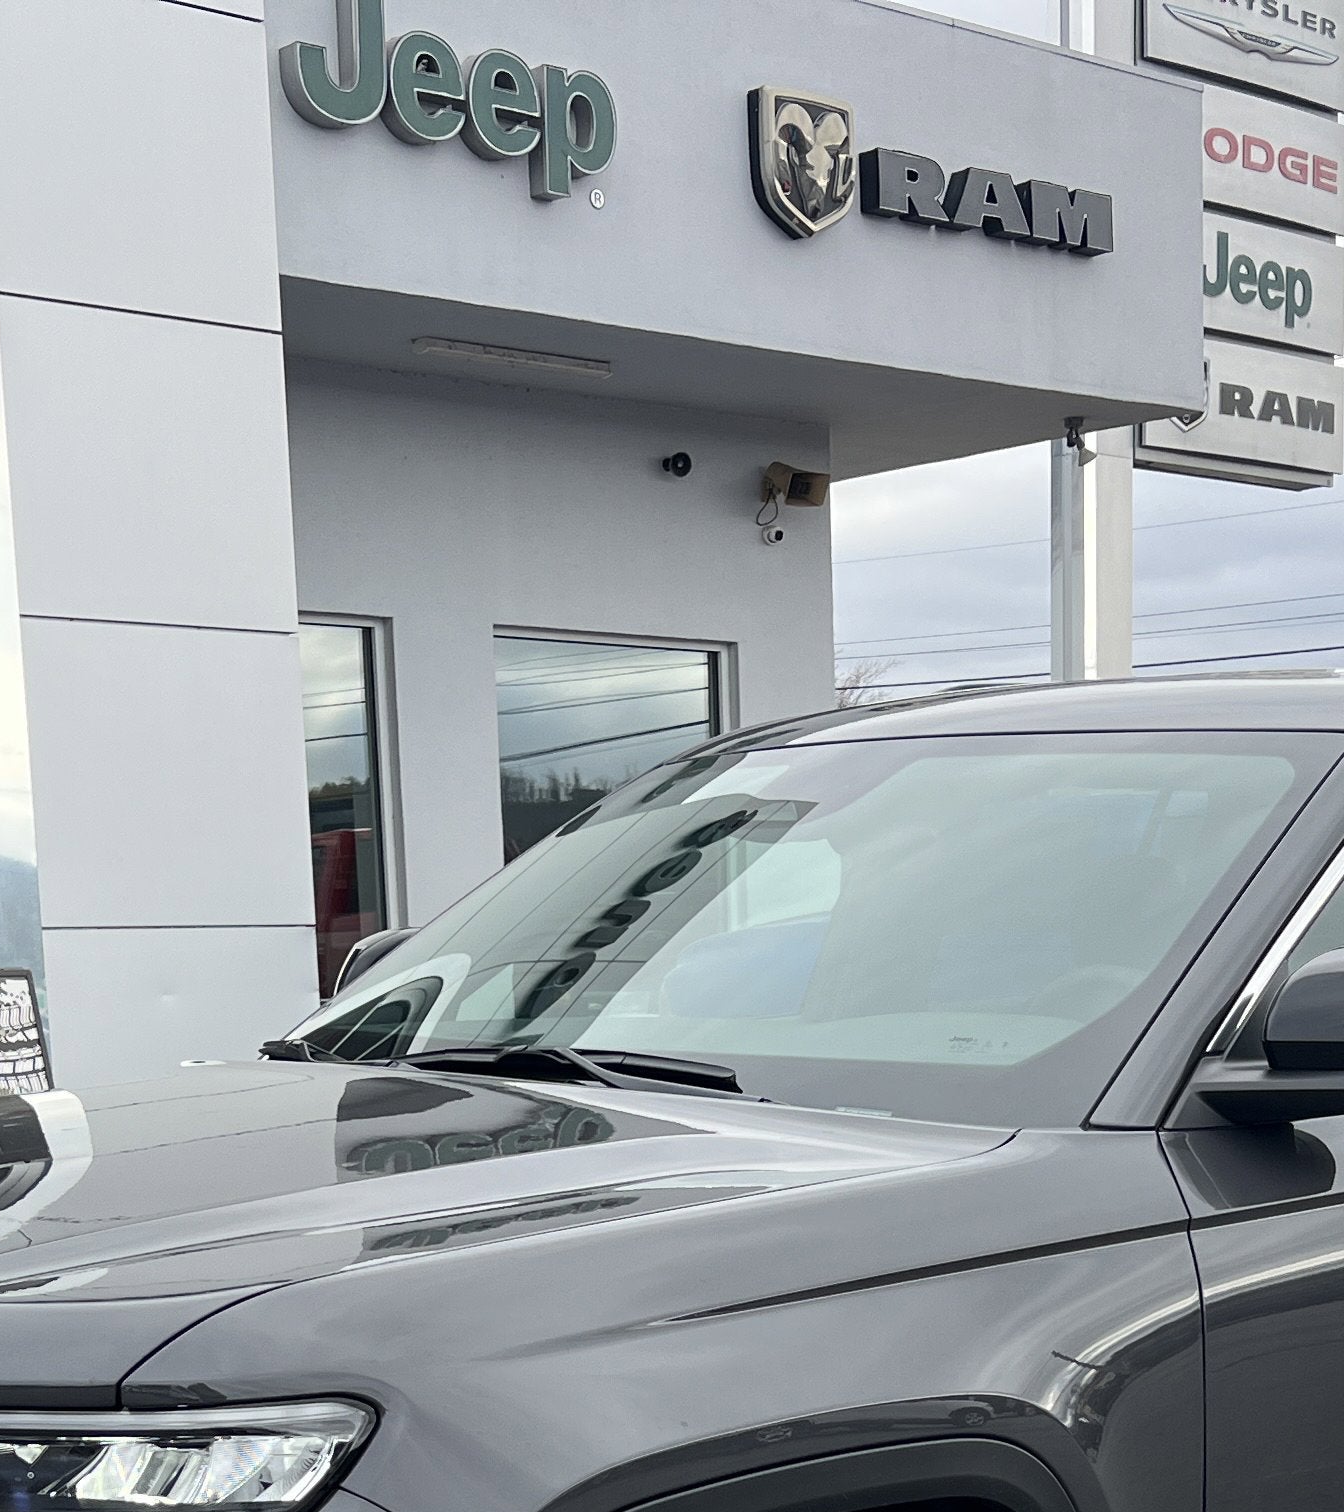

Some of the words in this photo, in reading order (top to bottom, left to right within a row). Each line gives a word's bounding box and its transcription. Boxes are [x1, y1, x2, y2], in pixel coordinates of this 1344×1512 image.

[1218, 0, 1337, 39] YSLER
[280, 0, 617, 201] Jeep
[1204, 127, 1338, 194] ODGE
[862, 147, 1114, 257] RAM
[1203, 231, 1312, 328] Jeep
[1219, 382, 1335, 434] RAM
